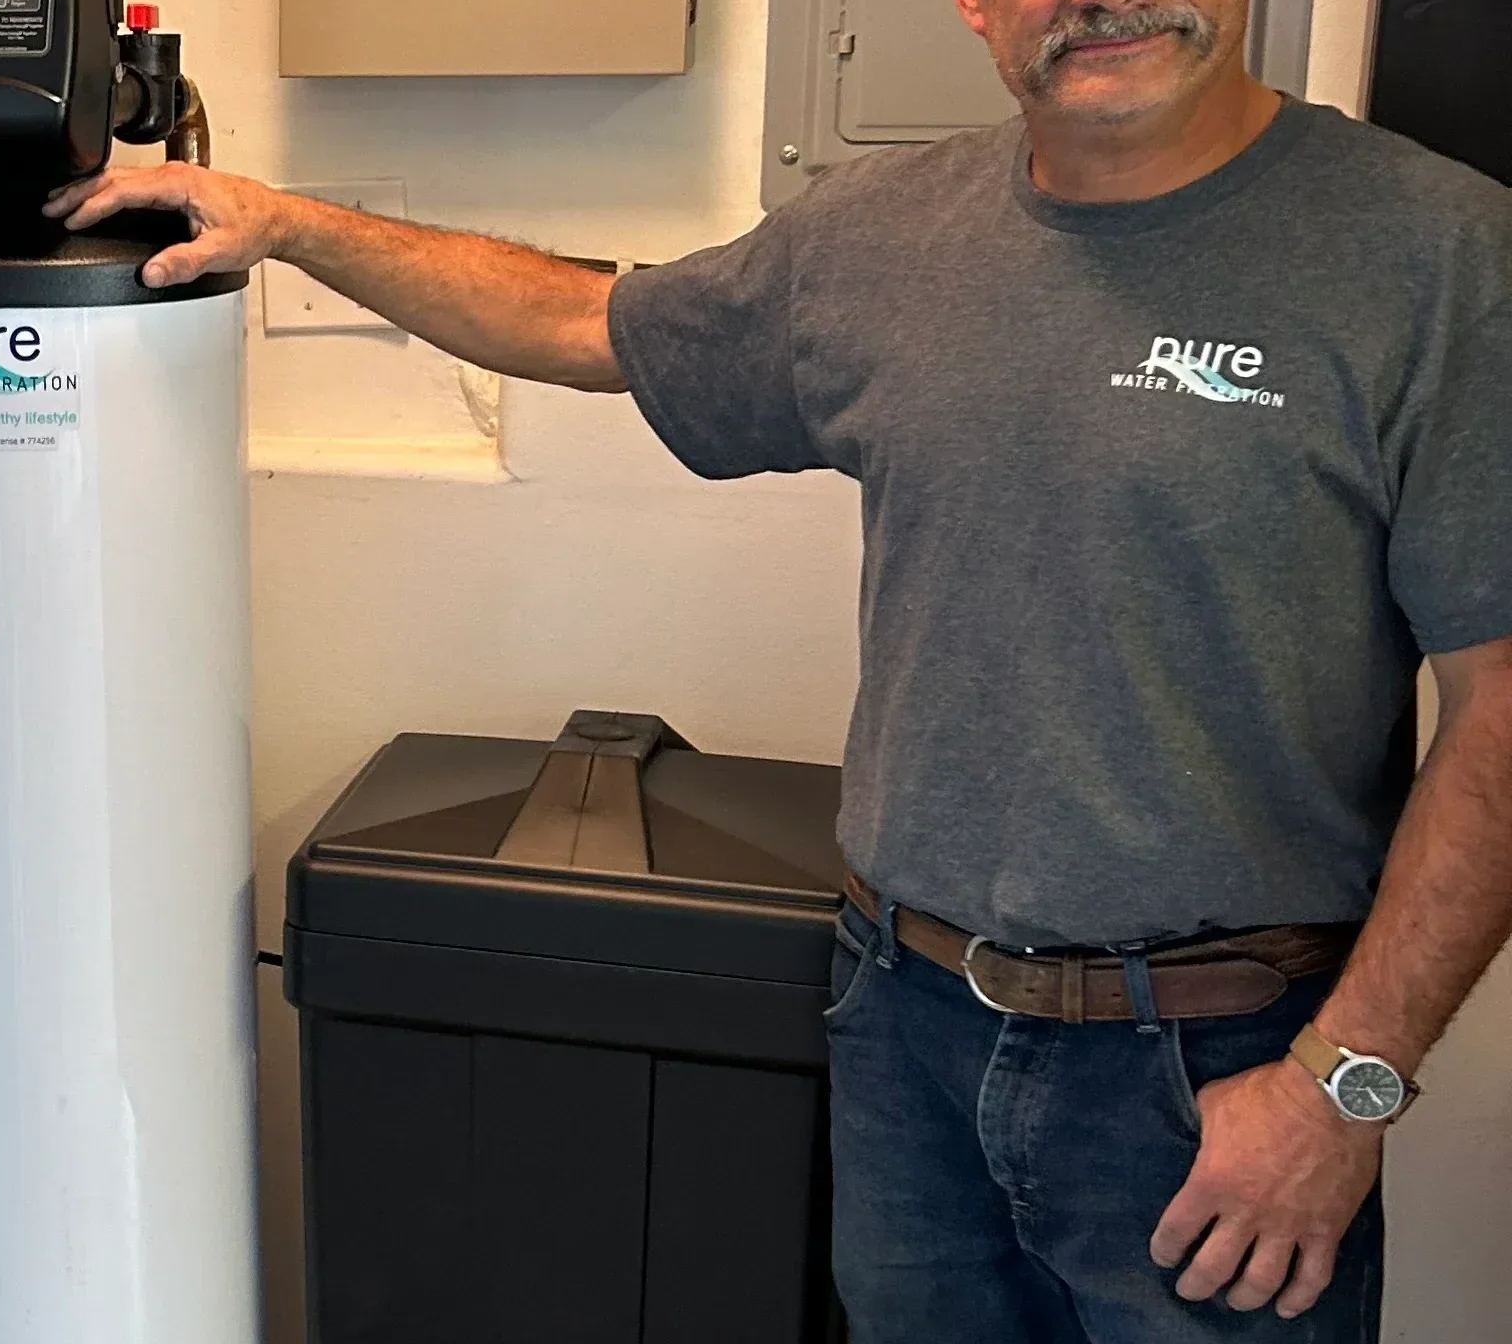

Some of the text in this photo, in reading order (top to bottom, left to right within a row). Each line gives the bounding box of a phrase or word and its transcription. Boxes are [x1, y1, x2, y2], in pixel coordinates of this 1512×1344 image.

[1146, 336, 1263, 378] pure
[1111, 374, 1168, 391] WATER
[25, 410, 77, 425] lifestyle
